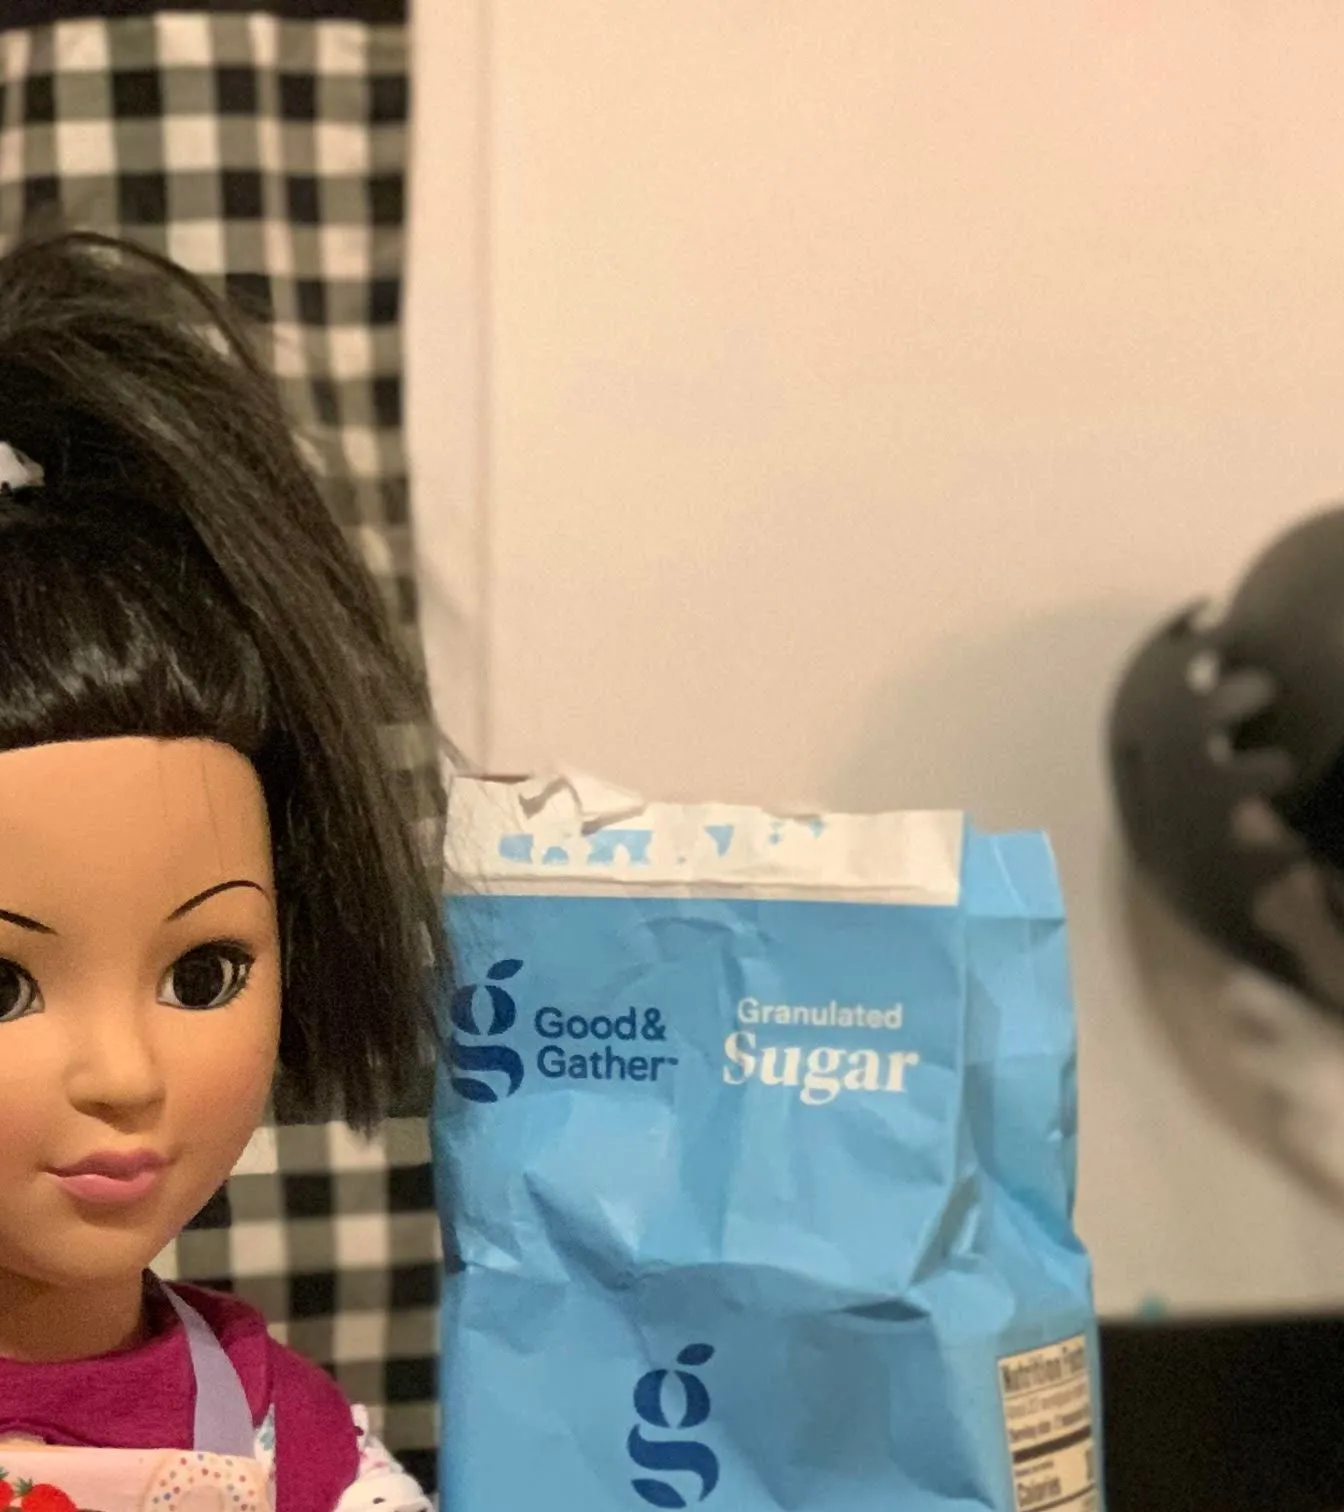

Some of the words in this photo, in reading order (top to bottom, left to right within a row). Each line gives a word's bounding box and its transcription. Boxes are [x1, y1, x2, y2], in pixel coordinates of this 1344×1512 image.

[534, 1006, 667, 1041] Good&
[737, 997, 903, 1029] Granulated
[723, 1031, 920, 1105] Sugar
